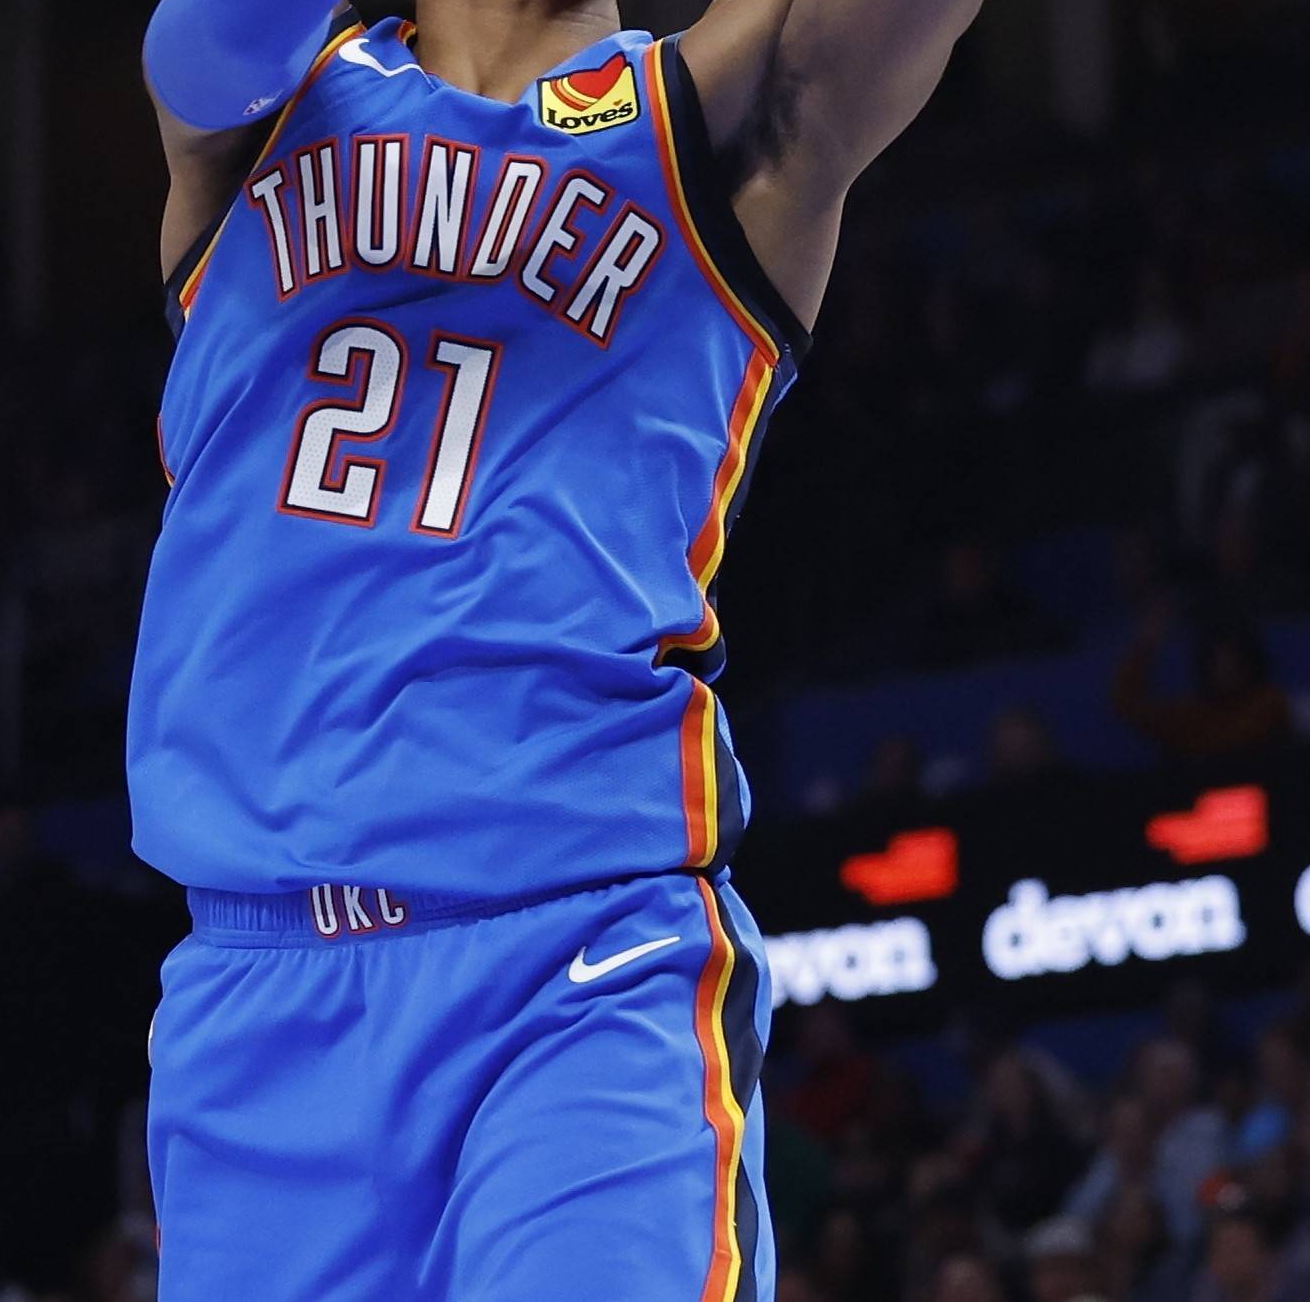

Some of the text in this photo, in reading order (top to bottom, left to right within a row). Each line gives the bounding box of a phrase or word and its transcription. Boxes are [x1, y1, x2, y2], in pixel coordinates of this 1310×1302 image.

[246, 134, 664, 350] THUNDER
[277, 317, 502, 539] 21
[982, 875, 1245, 980] devon
